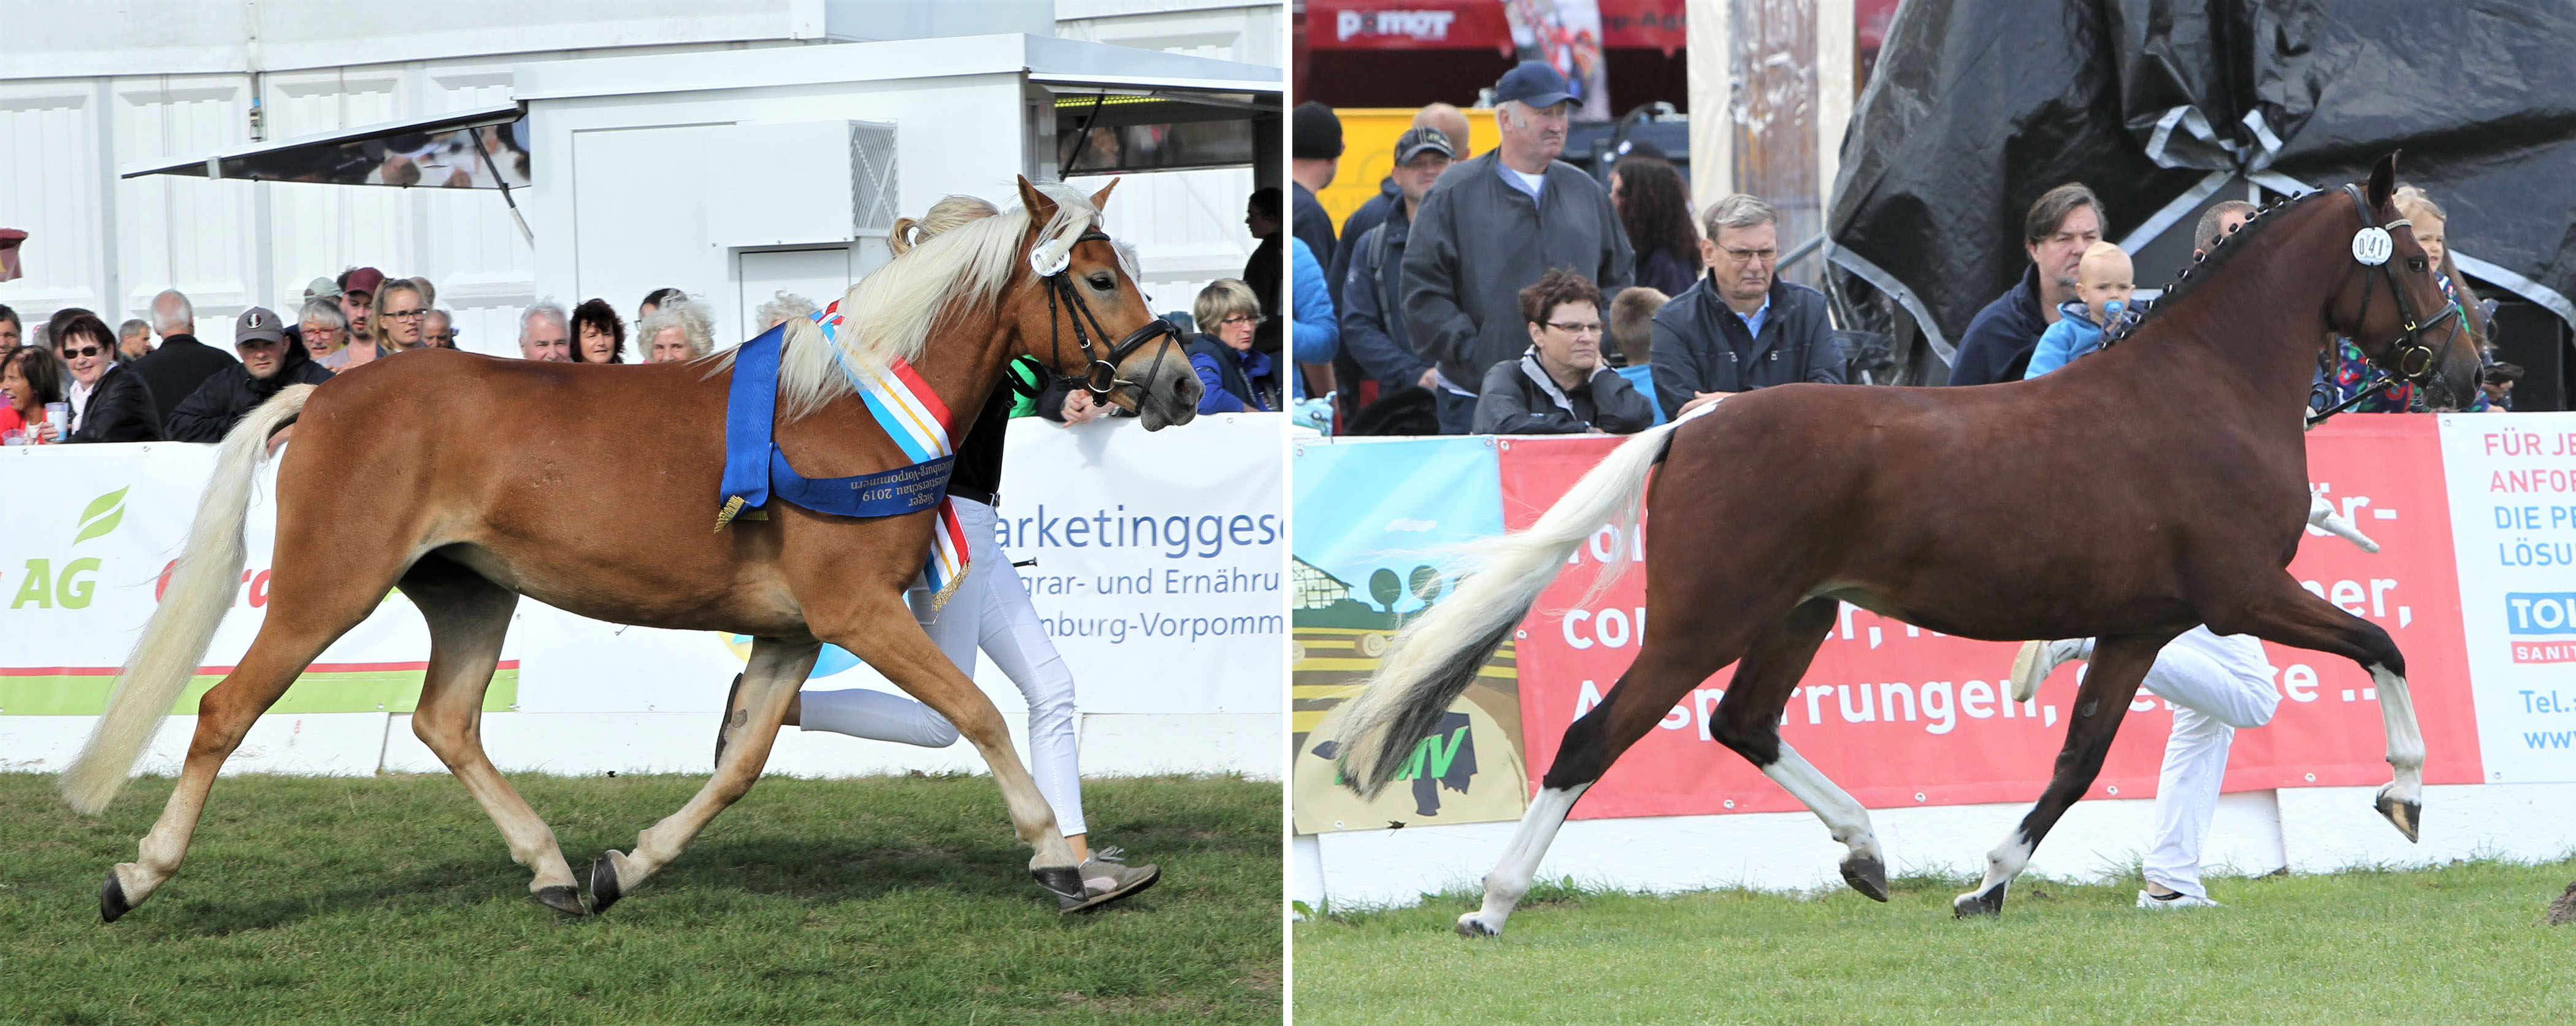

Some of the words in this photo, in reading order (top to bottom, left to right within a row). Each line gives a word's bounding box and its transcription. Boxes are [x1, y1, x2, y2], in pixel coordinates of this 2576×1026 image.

[2359, 237, 2384, 256] 041
[2485, 427, 2543, 456] FÜR
[862, 488, 892, 502] 2019
[908, 492, 934, 507] Sieger
[2494, 506, 2542, 529] DIE
[995, 504, 1283, 559] arketingges
[2499, 537, 2576, 567] LÖSU
[10, 557, 102, 610] AG
[1098, 568, 1152, 594] und
[1165, 567, 1279, 594] Ernähru
[2524, 731, 2576, 749] ww
